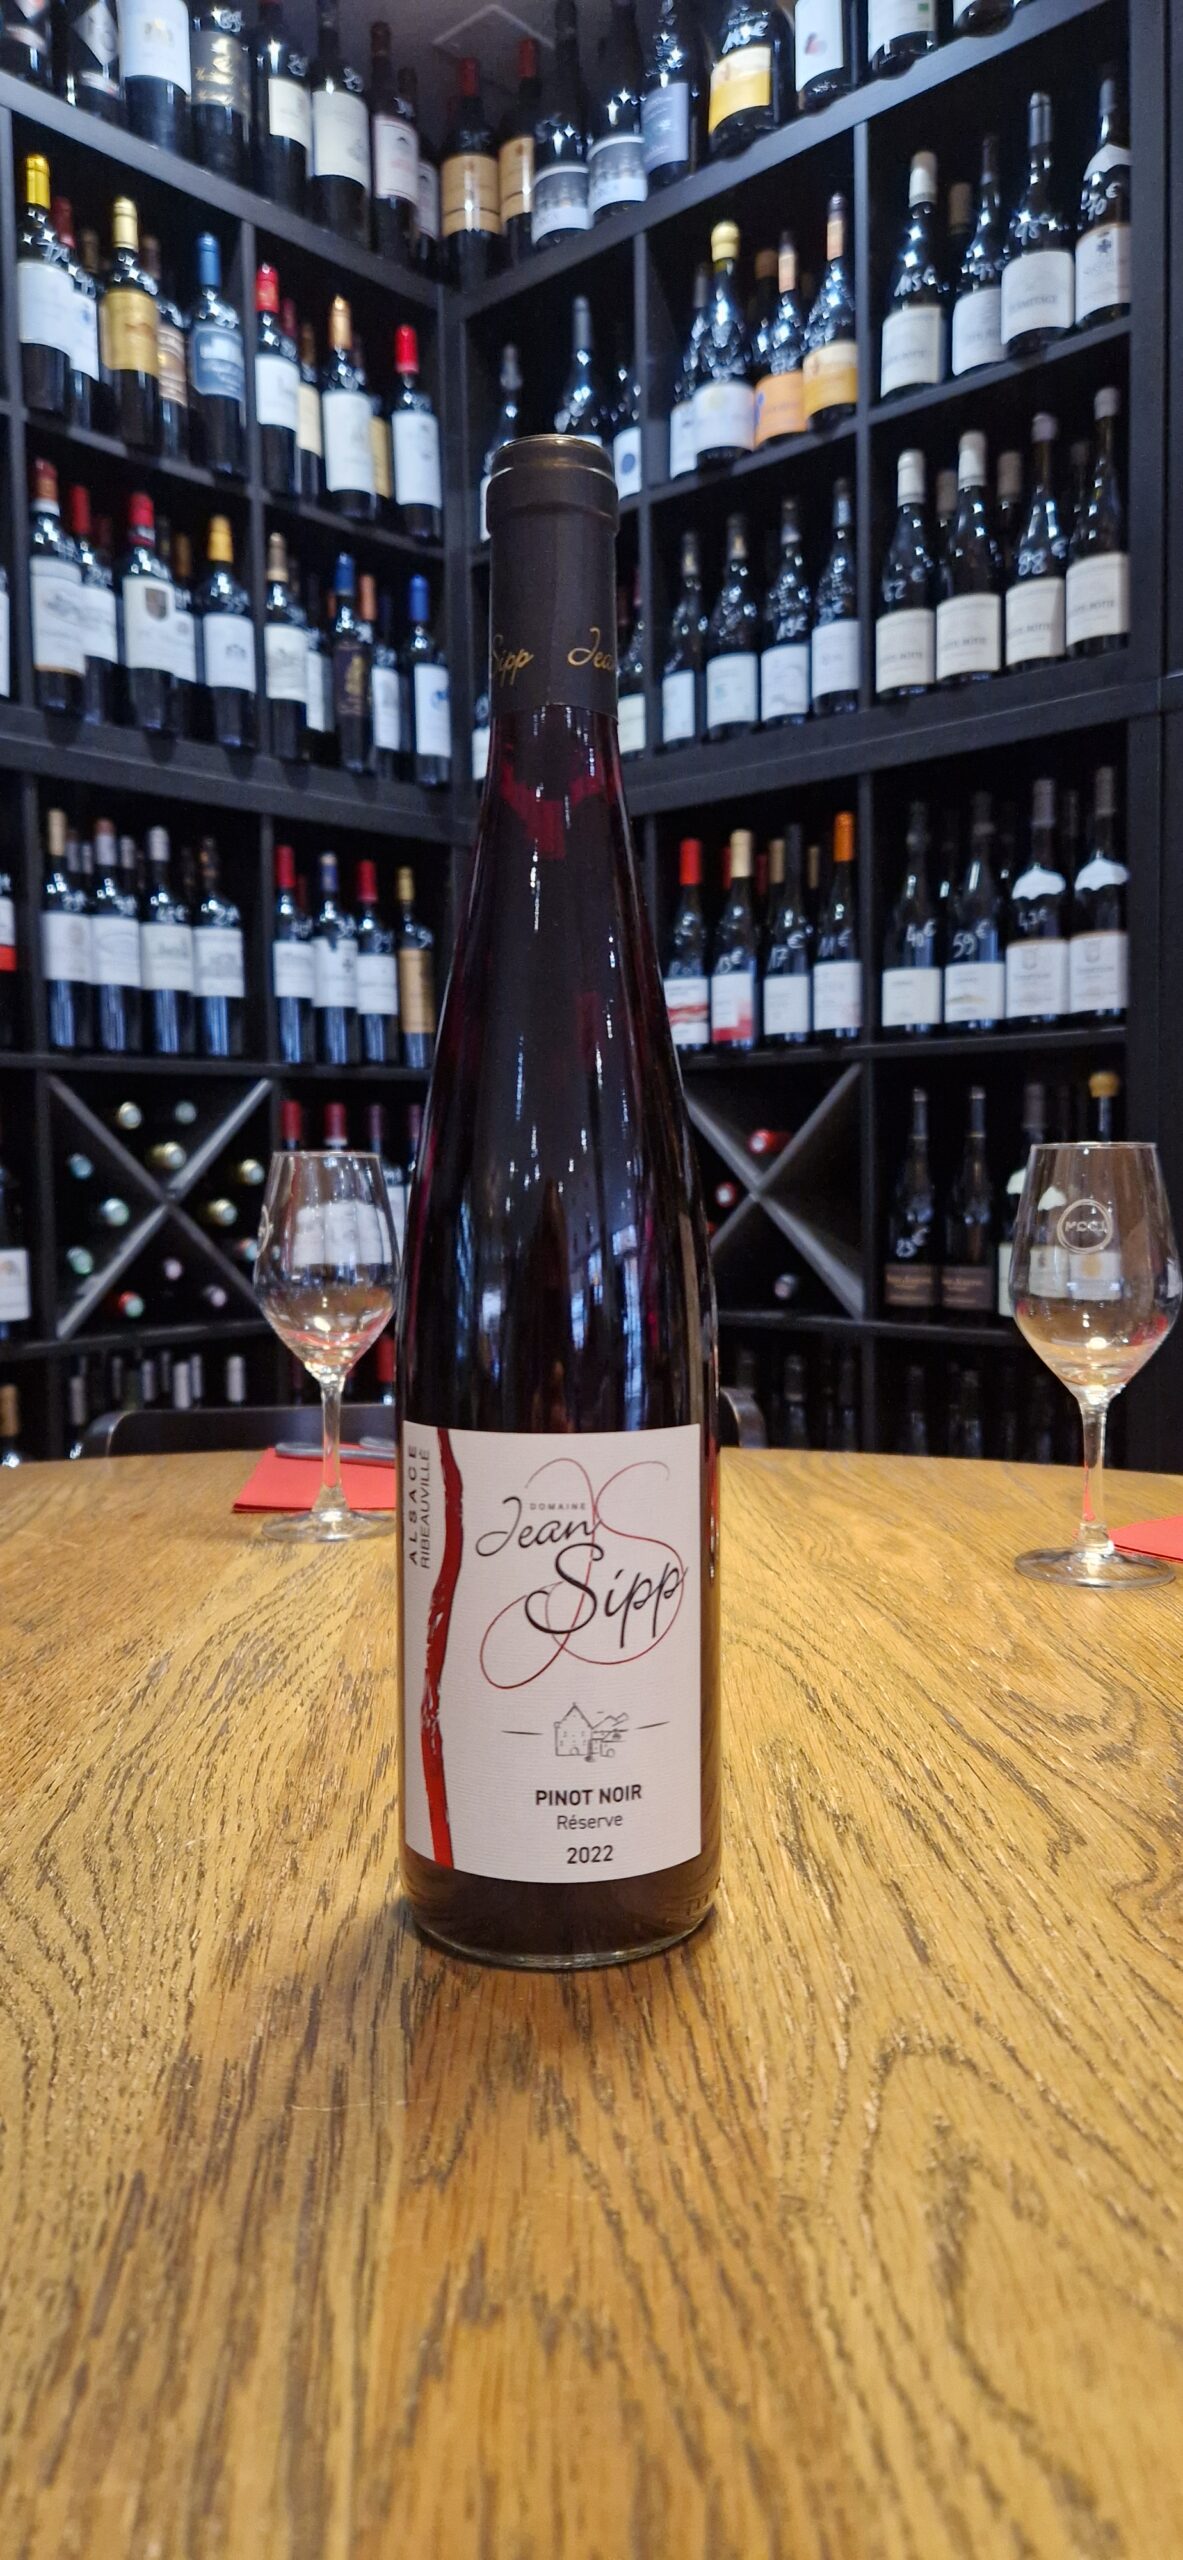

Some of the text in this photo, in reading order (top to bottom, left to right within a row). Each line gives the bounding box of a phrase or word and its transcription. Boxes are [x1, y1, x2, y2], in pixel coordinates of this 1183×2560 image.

[952, 919, 990, 959] 59€
[408, 1444, 418, 1566] ALSACE
[420, 1449, 431, 1569] RIBEAUVILLÉ
[529, 1502, 587, 1511] DOMAINE
[475, 1496, 602, 1557] Jean
[524, 1543, 689, 1649] Sipp
[535, 1784, 642, 1806] PINOT NOIR
[556, 1814, 624, 1830] Réserve
[566, 1845, 614, 1865] 2022
